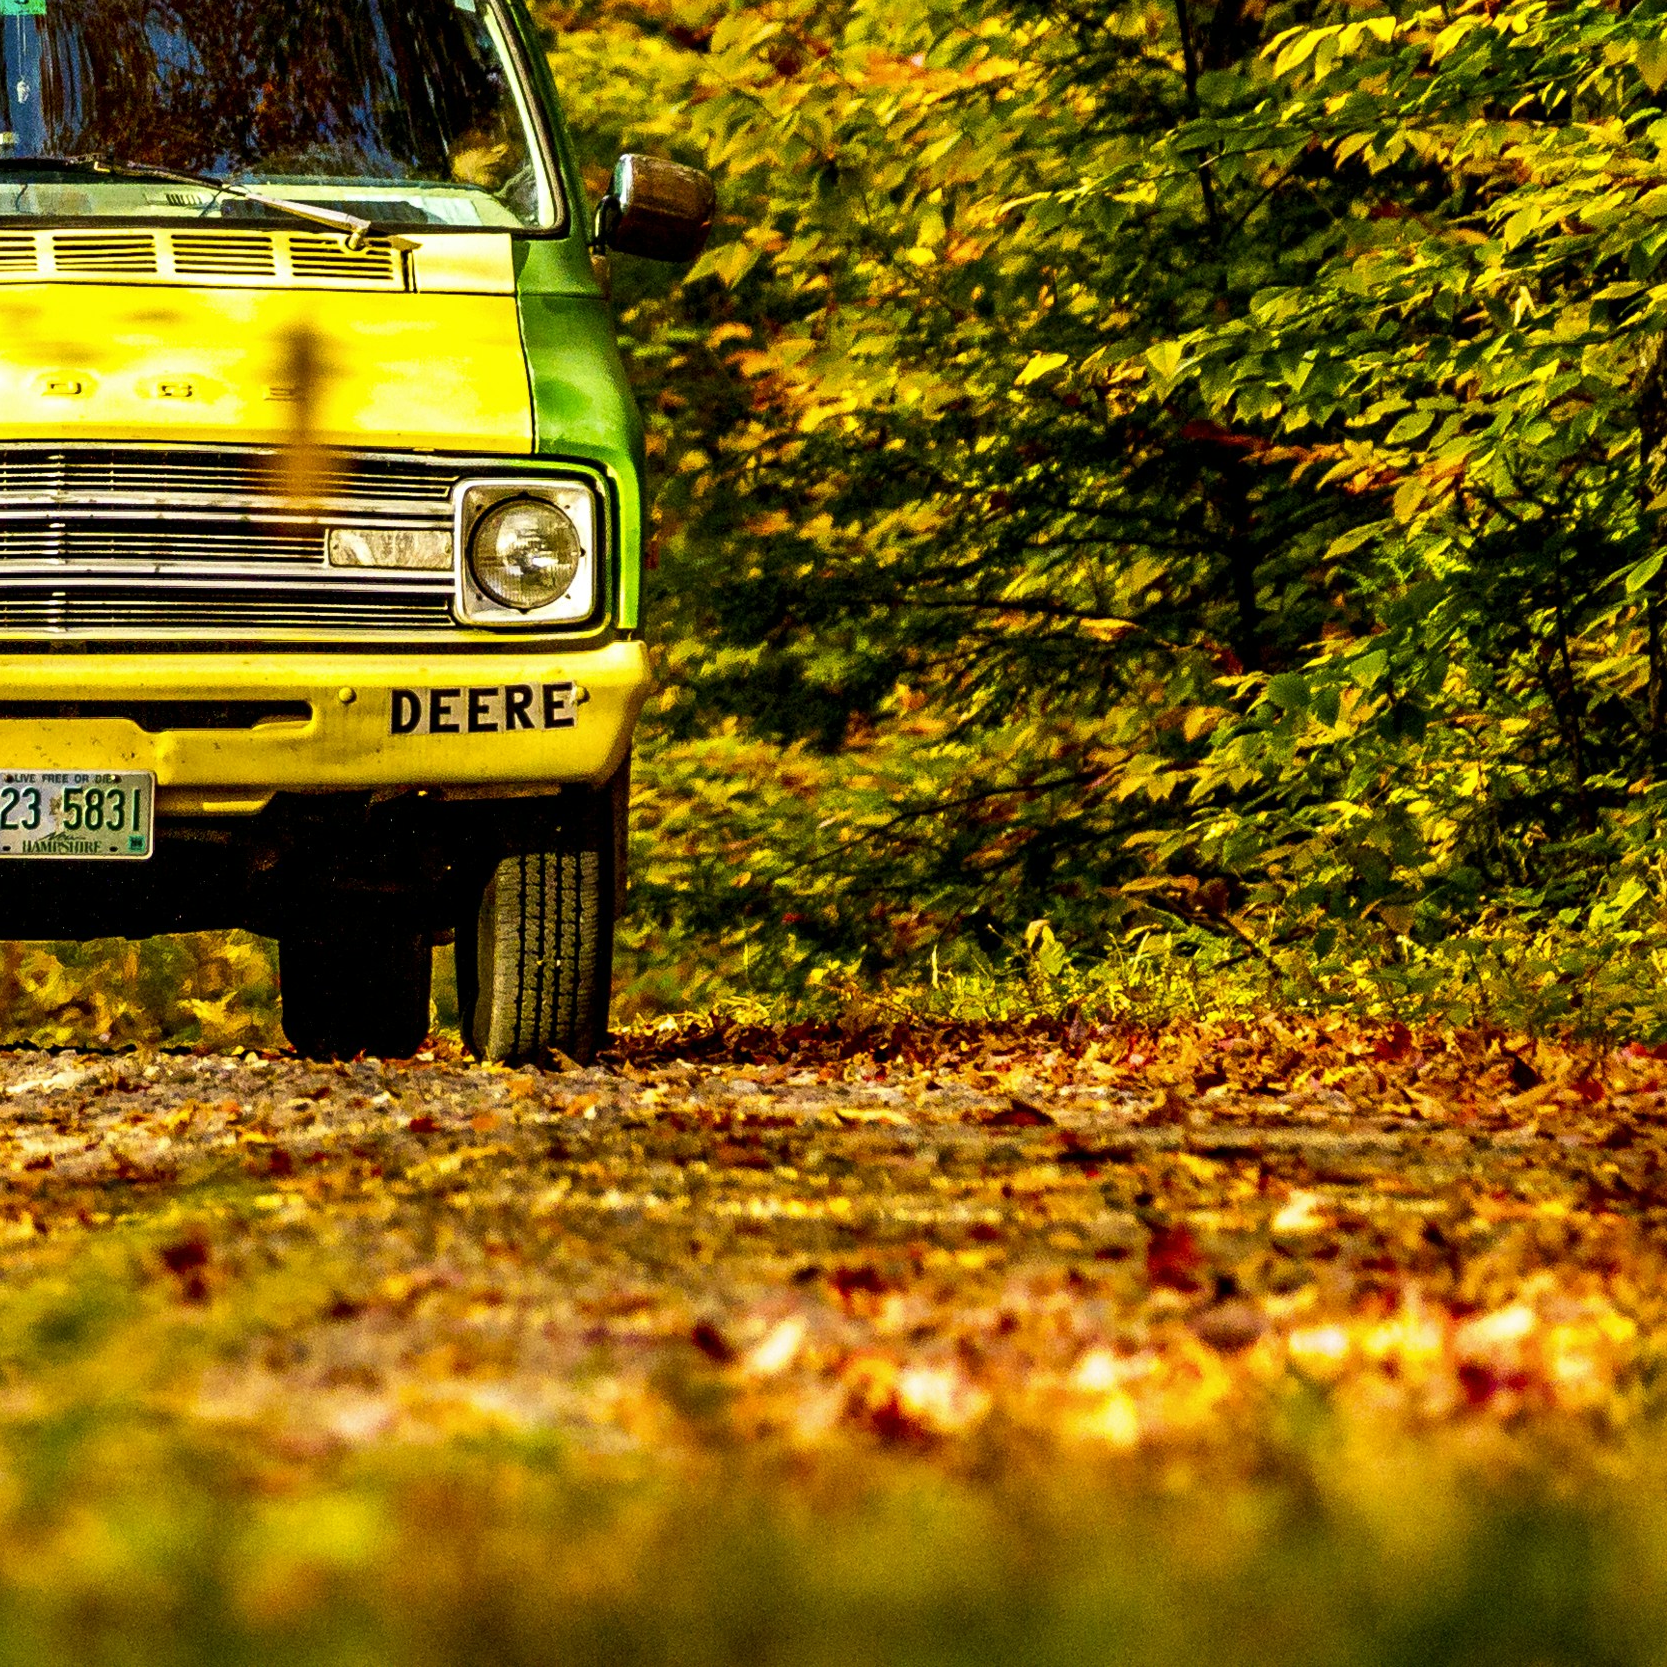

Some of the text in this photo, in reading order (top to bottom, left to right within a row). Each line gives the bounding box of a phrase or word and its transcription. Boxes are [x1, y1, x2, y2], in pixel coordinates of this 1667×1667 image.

[390, 681, 575, 735] DEERE
[14, 773, 37, 783] LIVE
[42, 773, 68, 783] FREE
[74, 774, 89, 784] OR
[62, 787, 141, 832] 5831
[22, 840, 102, 854] HAMPSHIRE
